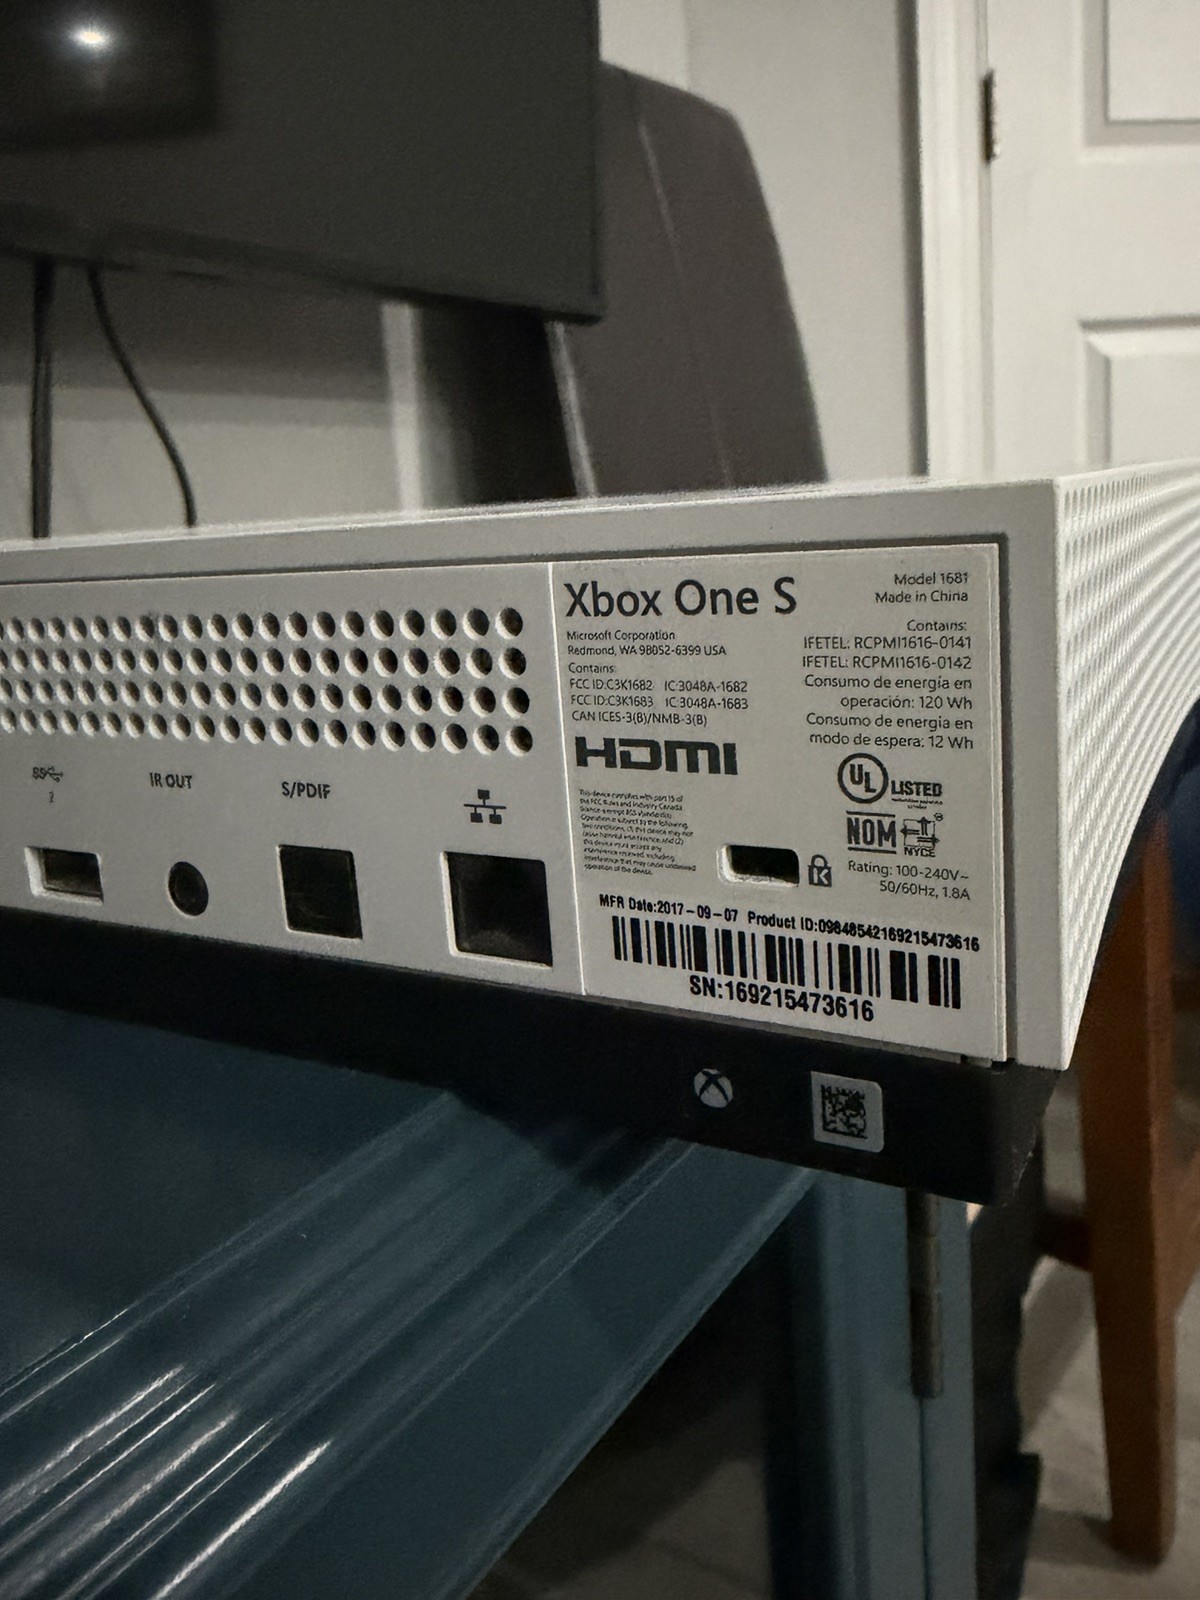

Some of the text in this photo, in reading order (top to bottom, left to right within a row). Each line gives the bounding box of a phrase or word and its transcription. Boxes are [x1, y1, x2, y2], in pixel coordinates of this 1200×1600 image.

[894, 572, 968, 586] Model 1681
[564, 576, 797, 617] Xbox One S
[875, 590, 968, 603] Made in China
[906, 619, 967, 632] Contains:
[566, 629, 675, 643] Microsoft Corporation
[803, 636, 850, 650] IFETEL:
[568, 645, 726, 657] Redmond, WA 98052-6399 USA
[802, 656, 849, 669] IFETEL:
[569, 679, 591, 690] FCC
[804, 674, 972, 692] Consumo de energía en
[570, 695, 593, 706] FCC
[840, 695, 973, 710] operación: 120 Wh
[572, 711, 595, 722] CAN
[806, 713, 871, 727] Consumo
[875, 715, 892, 727] de
[955, 719, 973, 730] en
[809, 732, 974, 750] modo de espera: 12 Wh
[574, 736, 738, 775] HDMI
[149, 772, 193, 789] IR OUT
[849, 763, 877, 794] UL
[281, 781, 331, 800] S/PDIF
[891, 780, 943, 798] LISTED
[847, 817, 897, 848] NOM
[903, 847, 936, 858] NYCE
[848, 860, 893, 878] Rating:
[880, 880, 971, 900] 50/60Hz, 1.8A
[599, 894, 625, 909] MFR
[748, 910, 796, 930] Product
[689, 975, 874, 1022] SN:169215473616
